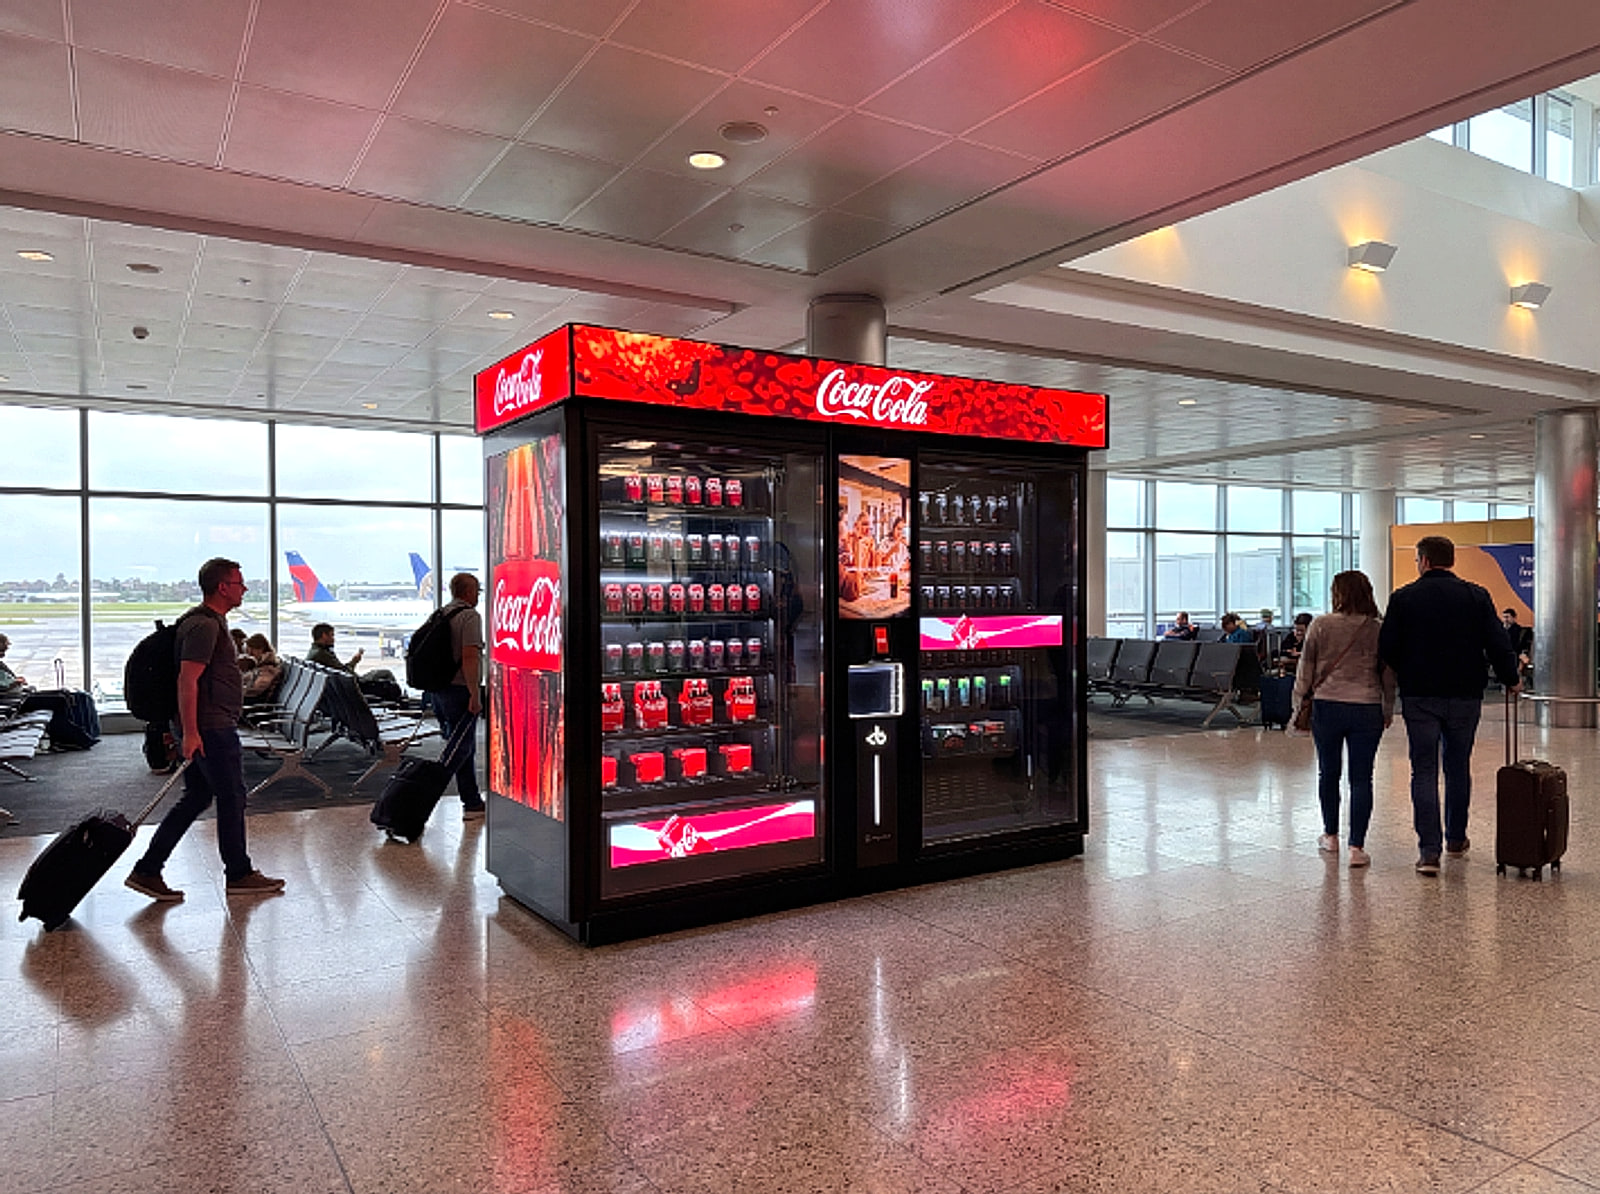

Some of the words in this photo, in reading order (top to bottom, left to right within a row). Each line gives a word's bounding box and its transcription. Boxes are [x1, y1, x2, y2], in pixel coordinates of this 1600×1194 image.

[494, 348, 544, 416] Coca-Cola
[816, 368, 934, 425] Coca-Cola
[493, 577, 562, 655] Coca-Cola
